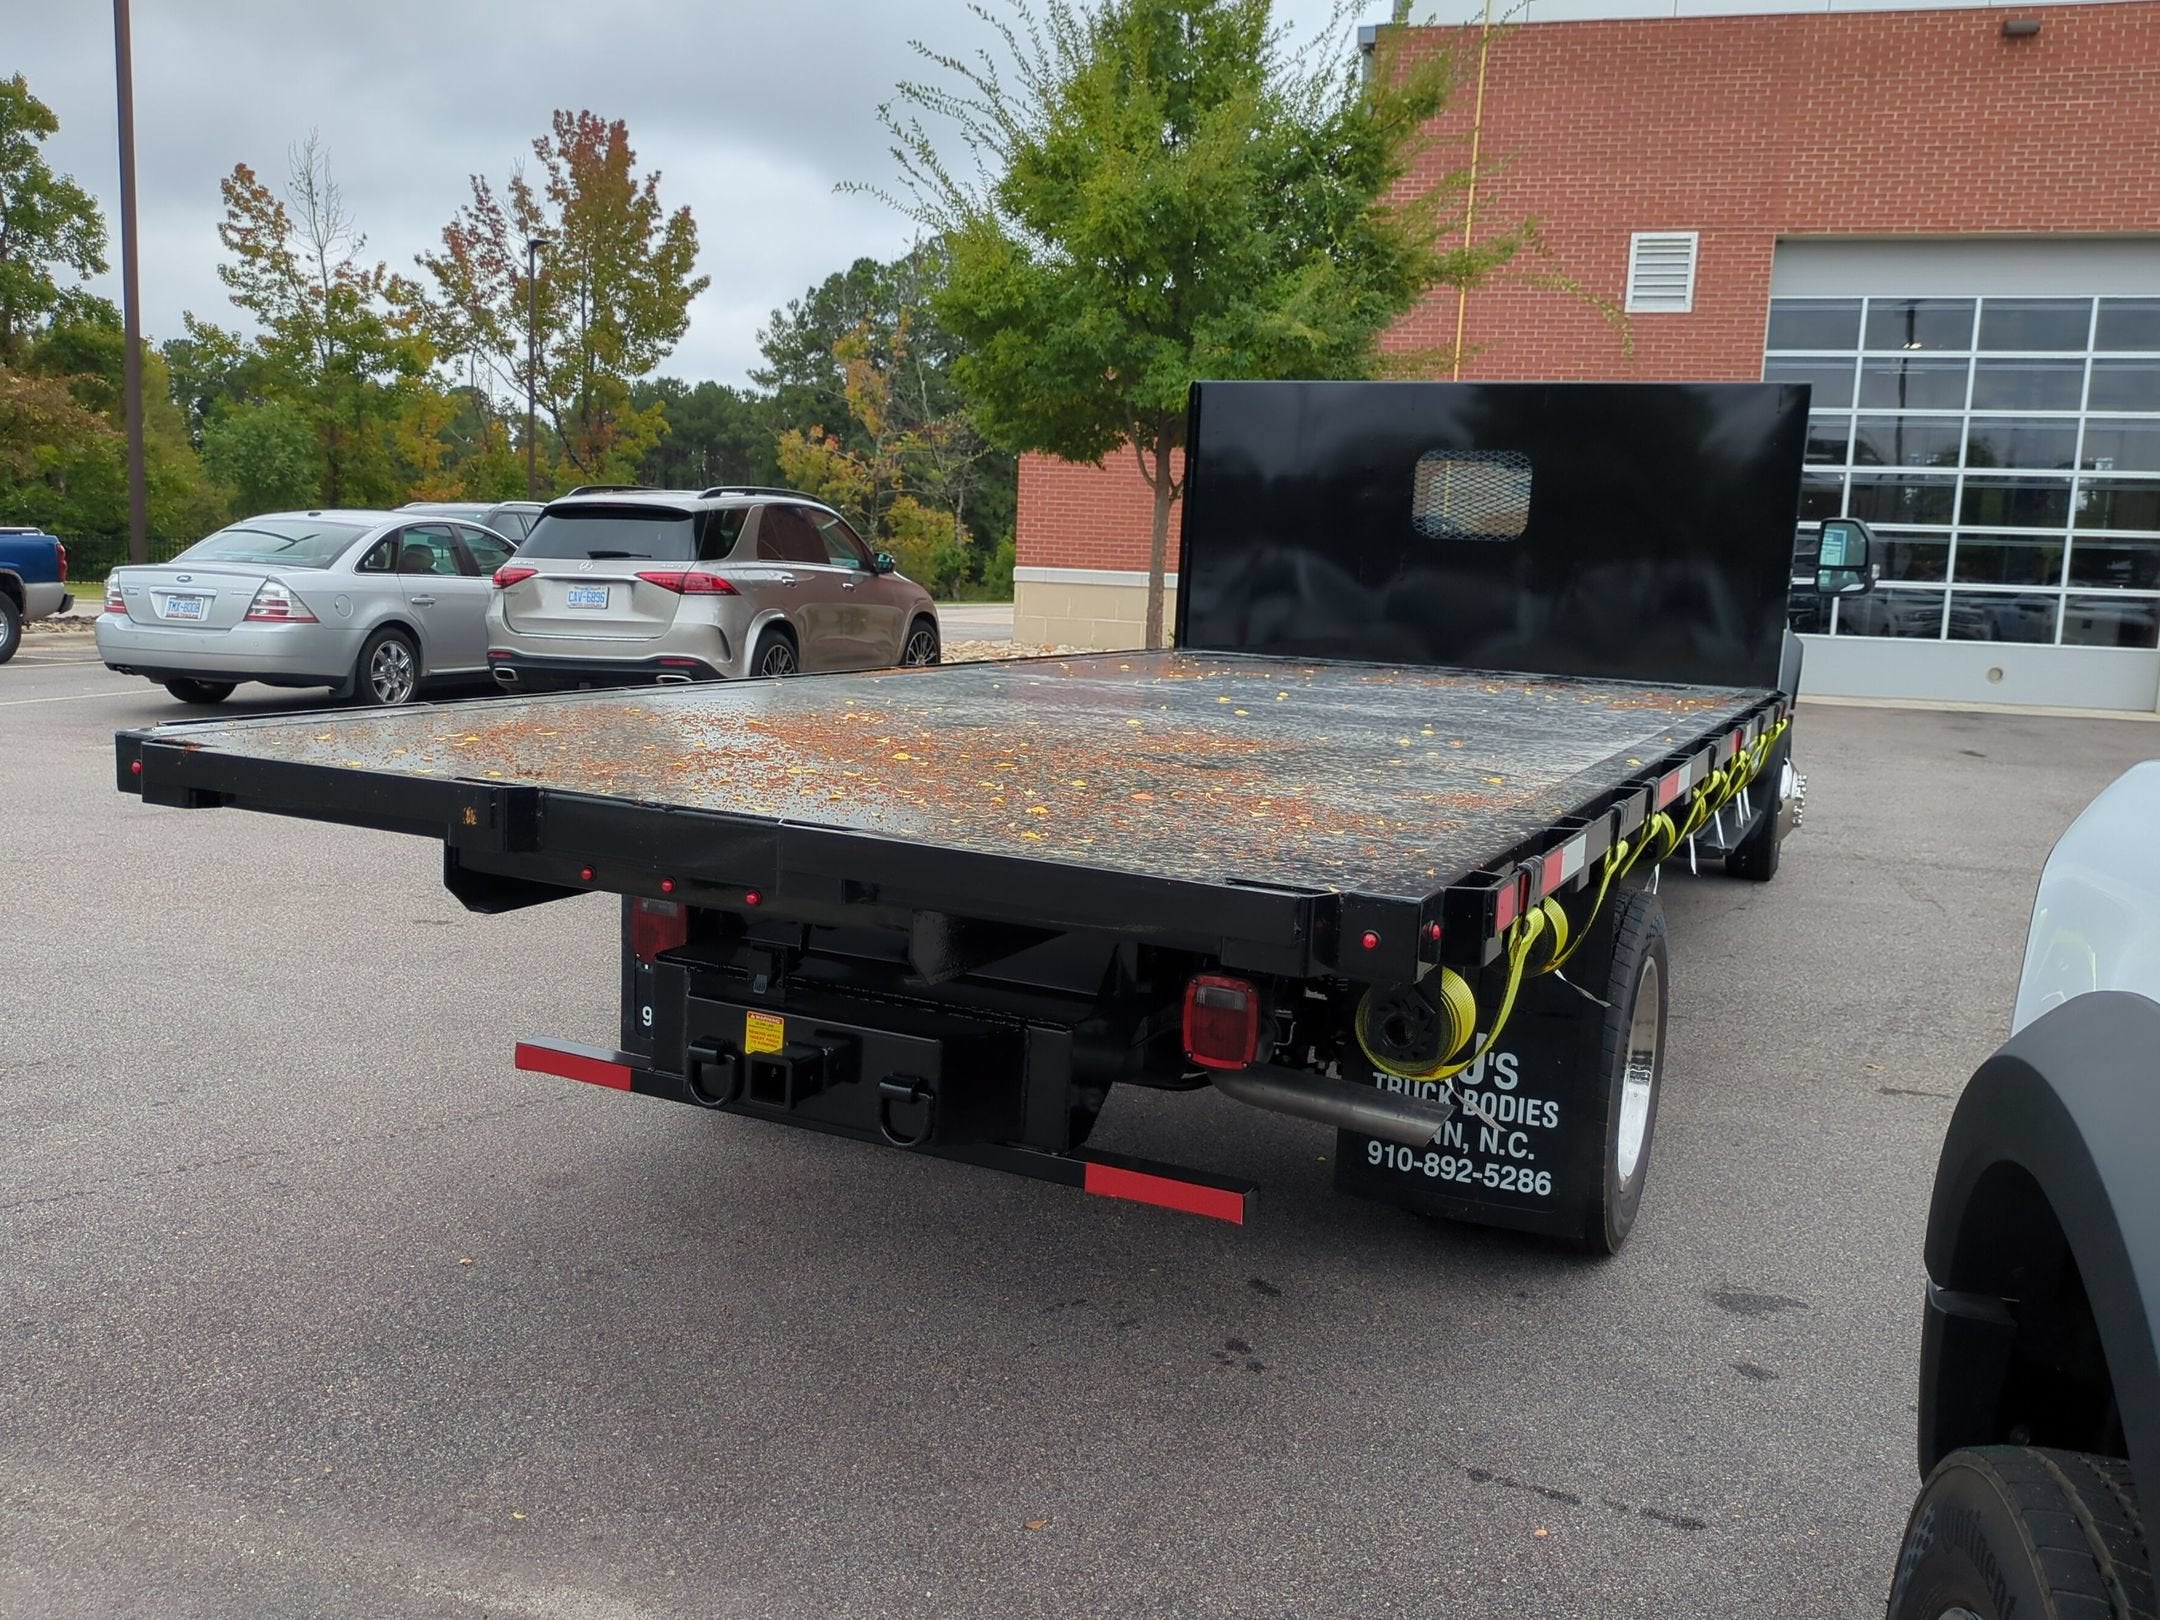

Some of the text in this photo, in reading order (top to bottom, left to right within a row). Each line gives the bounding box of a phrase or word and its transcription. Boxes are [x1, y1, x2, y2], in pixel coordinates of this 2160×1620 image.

[1462, 1088, 1559, 1129] BODIES
[1479, 1123, 1535, 1160] N.C.
[1367, 1140, 1552, 1196] 910-892-5286
